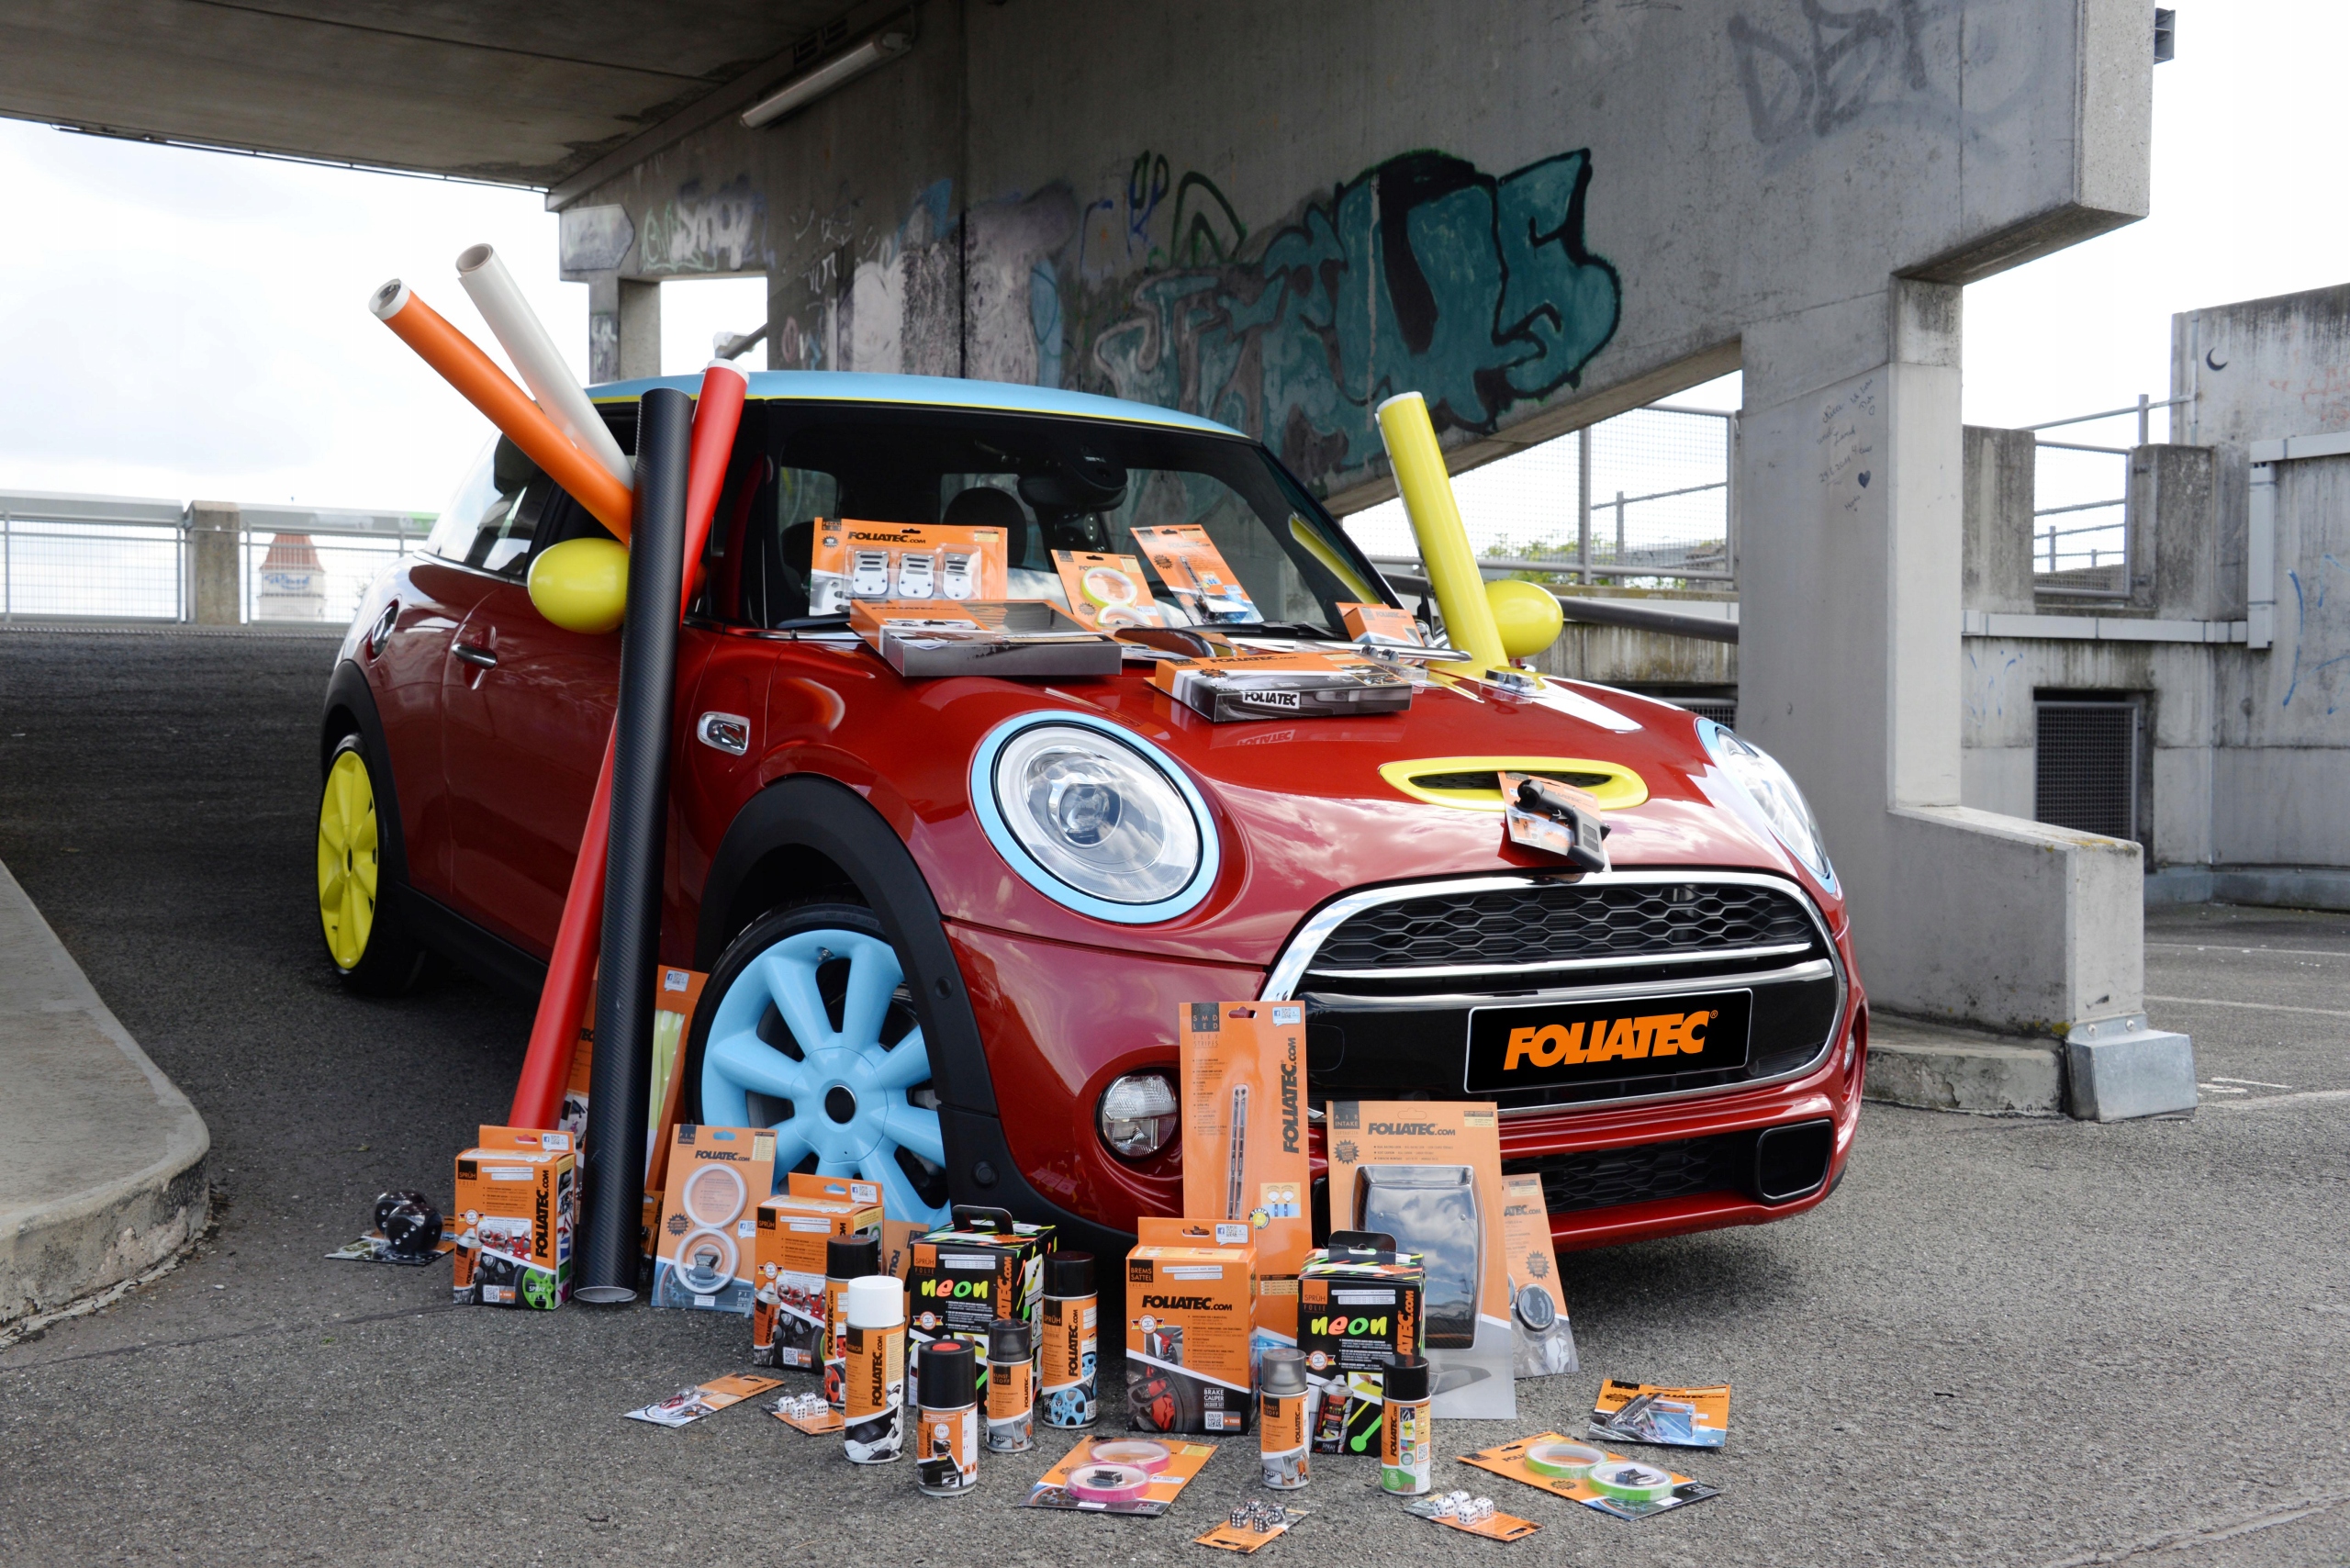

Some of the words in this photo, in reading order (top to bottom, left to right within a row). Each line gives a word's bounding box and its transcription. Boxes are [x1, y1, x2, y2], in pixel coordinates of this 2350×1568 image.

[1244, 691, 1298, 707] FOLIATEC
[458, 1171, 476, 1180] SPRÜH
[758, 1219, 776, 1228] SPRÜH
[915, 1257, 934, 1266] SPRÜH
[921, 1279, 989, 1299] neon
[1304, 1293, 1326, 1303] SPRÜH
[1044, 1315, 1061, 1325] SPRÜH
[1311, 1316, 1388, 1336] neon
